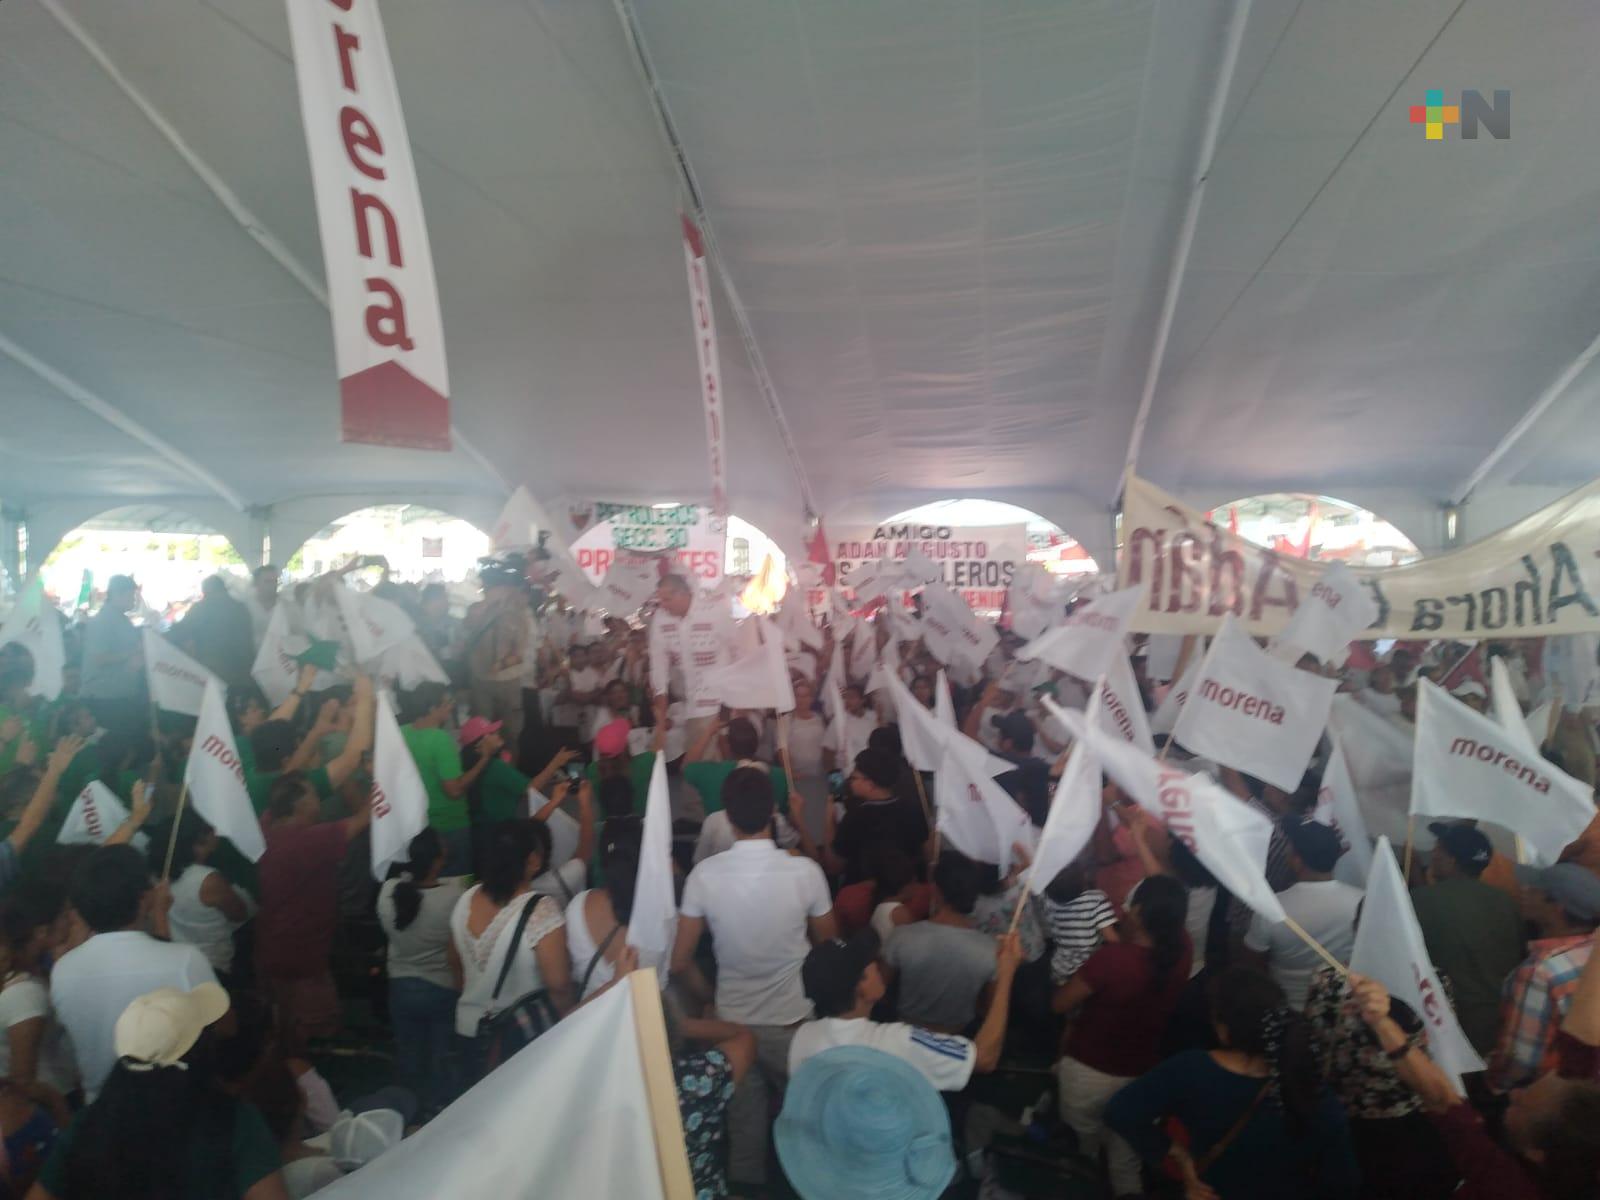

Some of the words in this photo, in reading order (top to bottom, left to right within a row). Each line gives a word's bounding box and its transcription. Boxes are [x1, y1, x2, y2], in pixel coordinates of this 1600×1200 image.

[325, 0, 415, 352] rena
[873, 525, 953, 541] AMIGO
[1199, 679, 1286, 727] morena
[1449, 735, 1553, 797] morena
